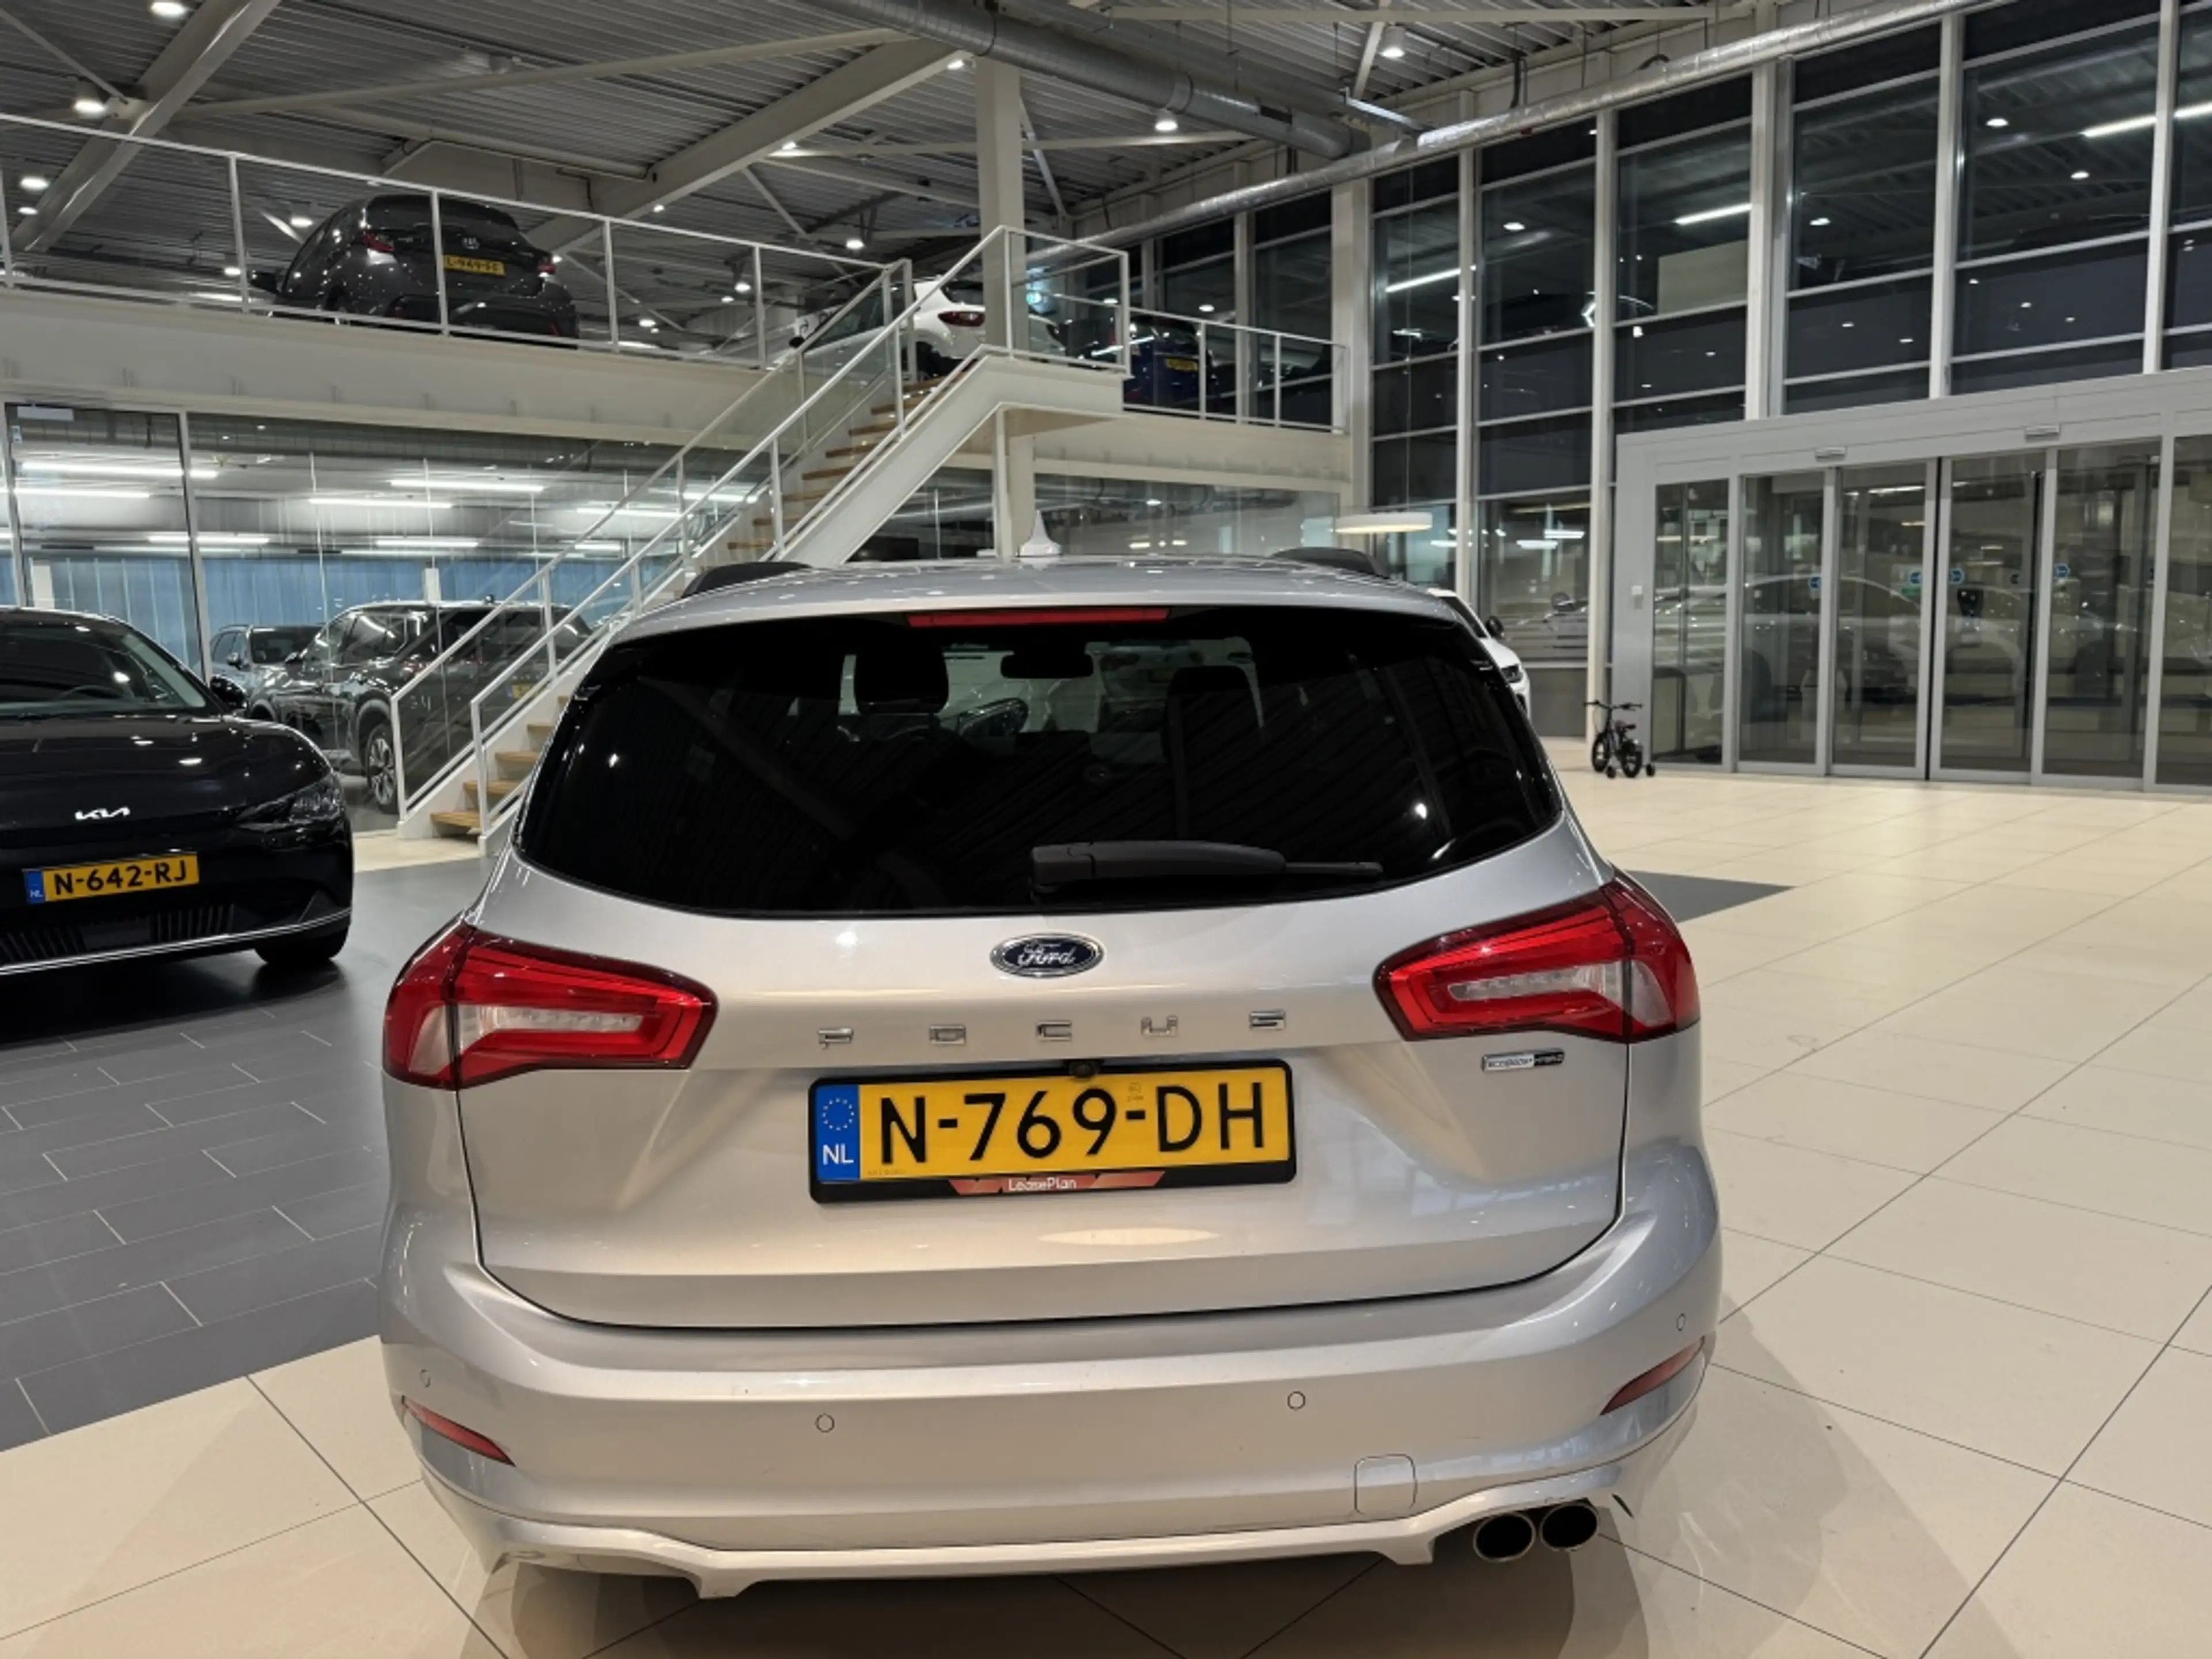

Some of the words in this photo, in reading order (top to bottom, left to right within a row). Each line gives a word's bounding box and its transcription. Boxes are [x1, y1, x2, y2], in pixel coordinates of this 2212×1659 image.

[75, 807, 130, 820] KIA
[54, 860, 186, 895] N-642-RJ
[30, 890, 44, 898] NL
[1017, 943, 1077, 966] Ford
[880, 1082, 1264, 1165] N-769-DH
[823, 1143, 854, 1165] NL
[1009, 1177, 1077, 1191] LeasePlan
